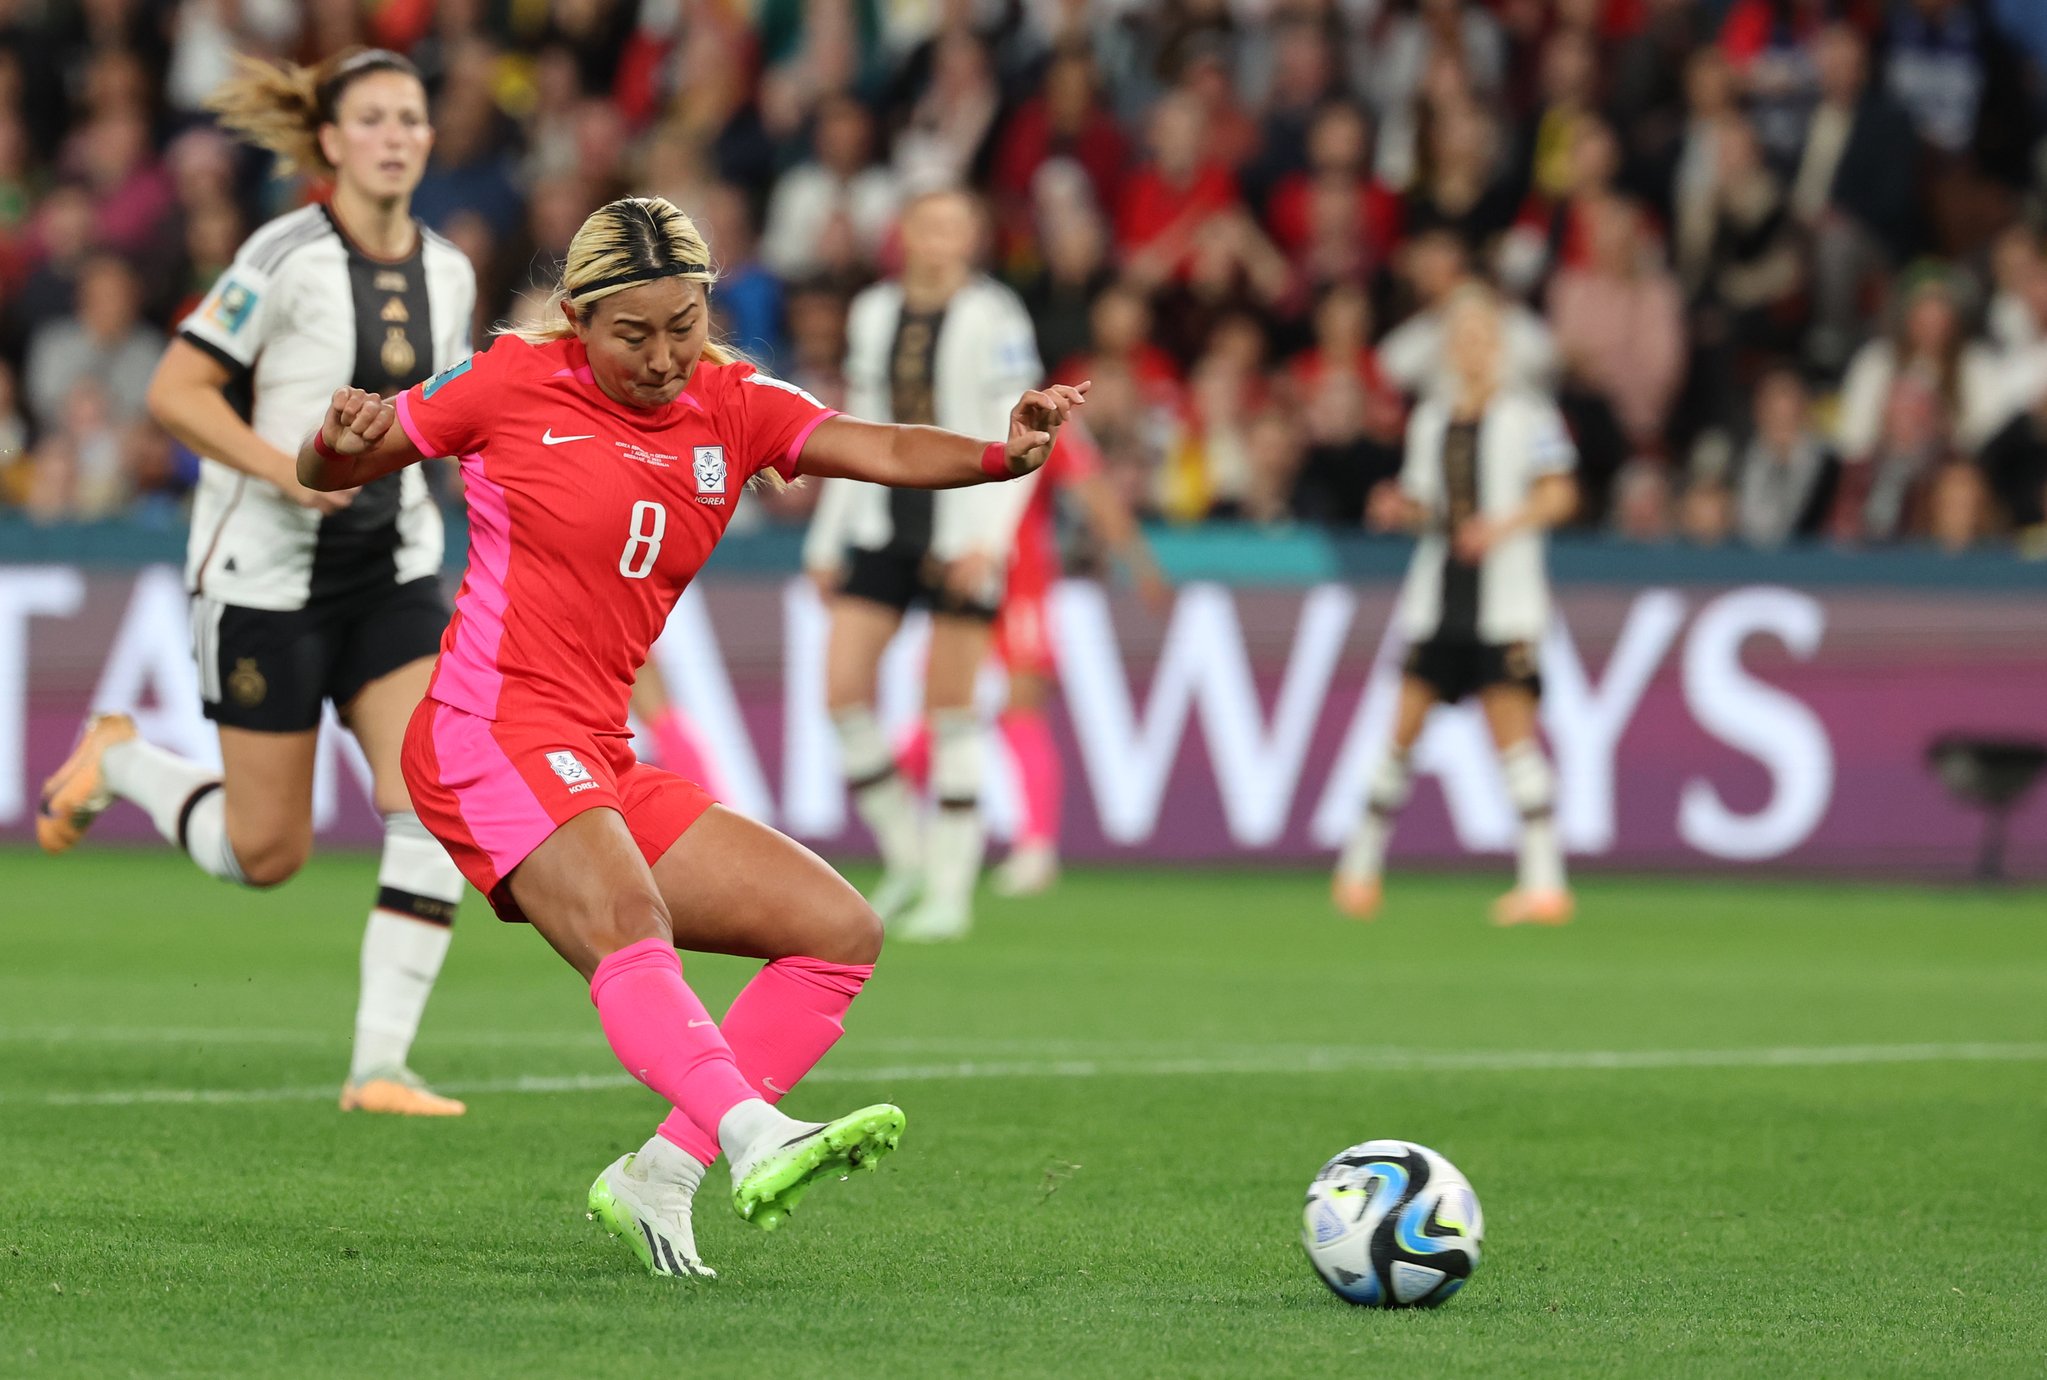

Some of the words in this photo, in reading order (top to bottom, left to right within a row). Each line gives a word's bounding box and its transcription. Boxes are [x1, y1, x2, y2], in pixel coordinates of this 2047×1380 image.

[695, 496, 725, 505] KOREA
[619, 500, 666, 579] 8
[568, 781, 600, 795] KOREA
